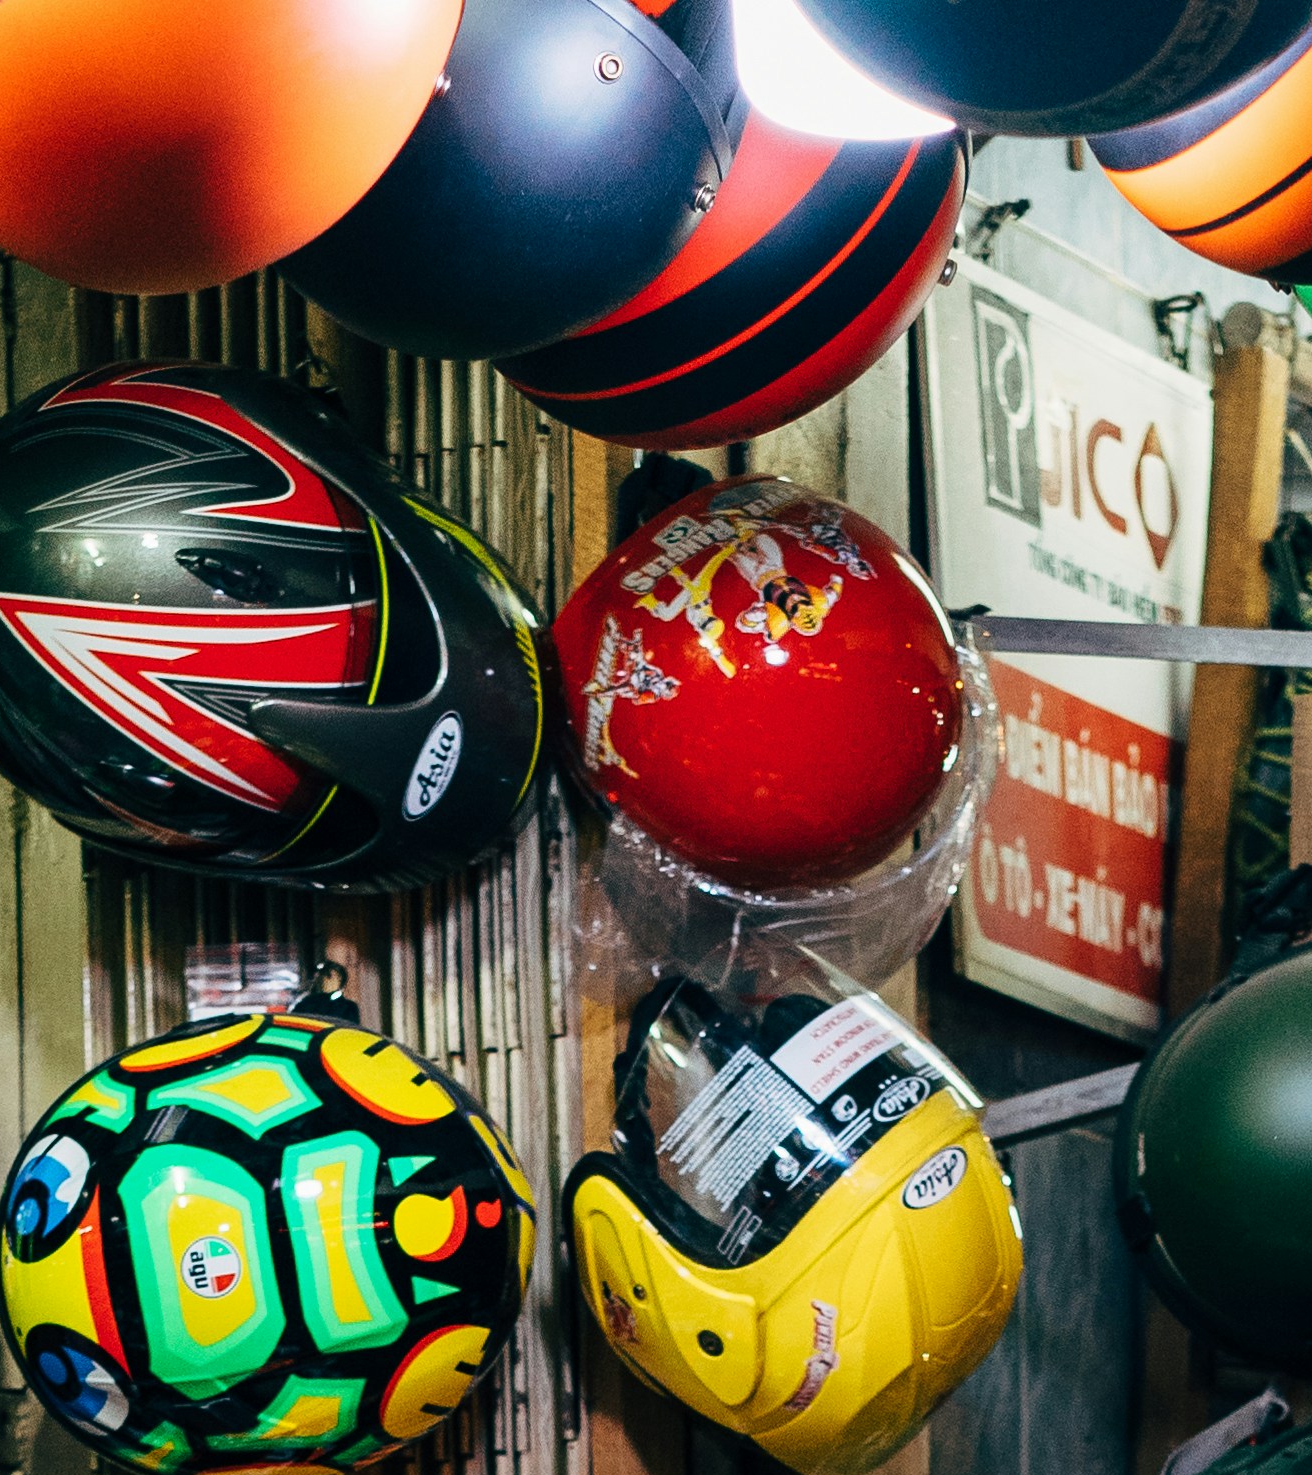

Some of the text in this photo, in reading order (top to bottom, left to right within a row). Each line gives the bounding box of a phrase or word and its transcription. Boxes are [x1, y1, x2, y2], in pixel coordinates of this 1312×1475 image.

[419, 731, 455, 807] Asia
[876, 1078, 927, 1121] Asia
[908, 1153, 968, 1206] Asia
